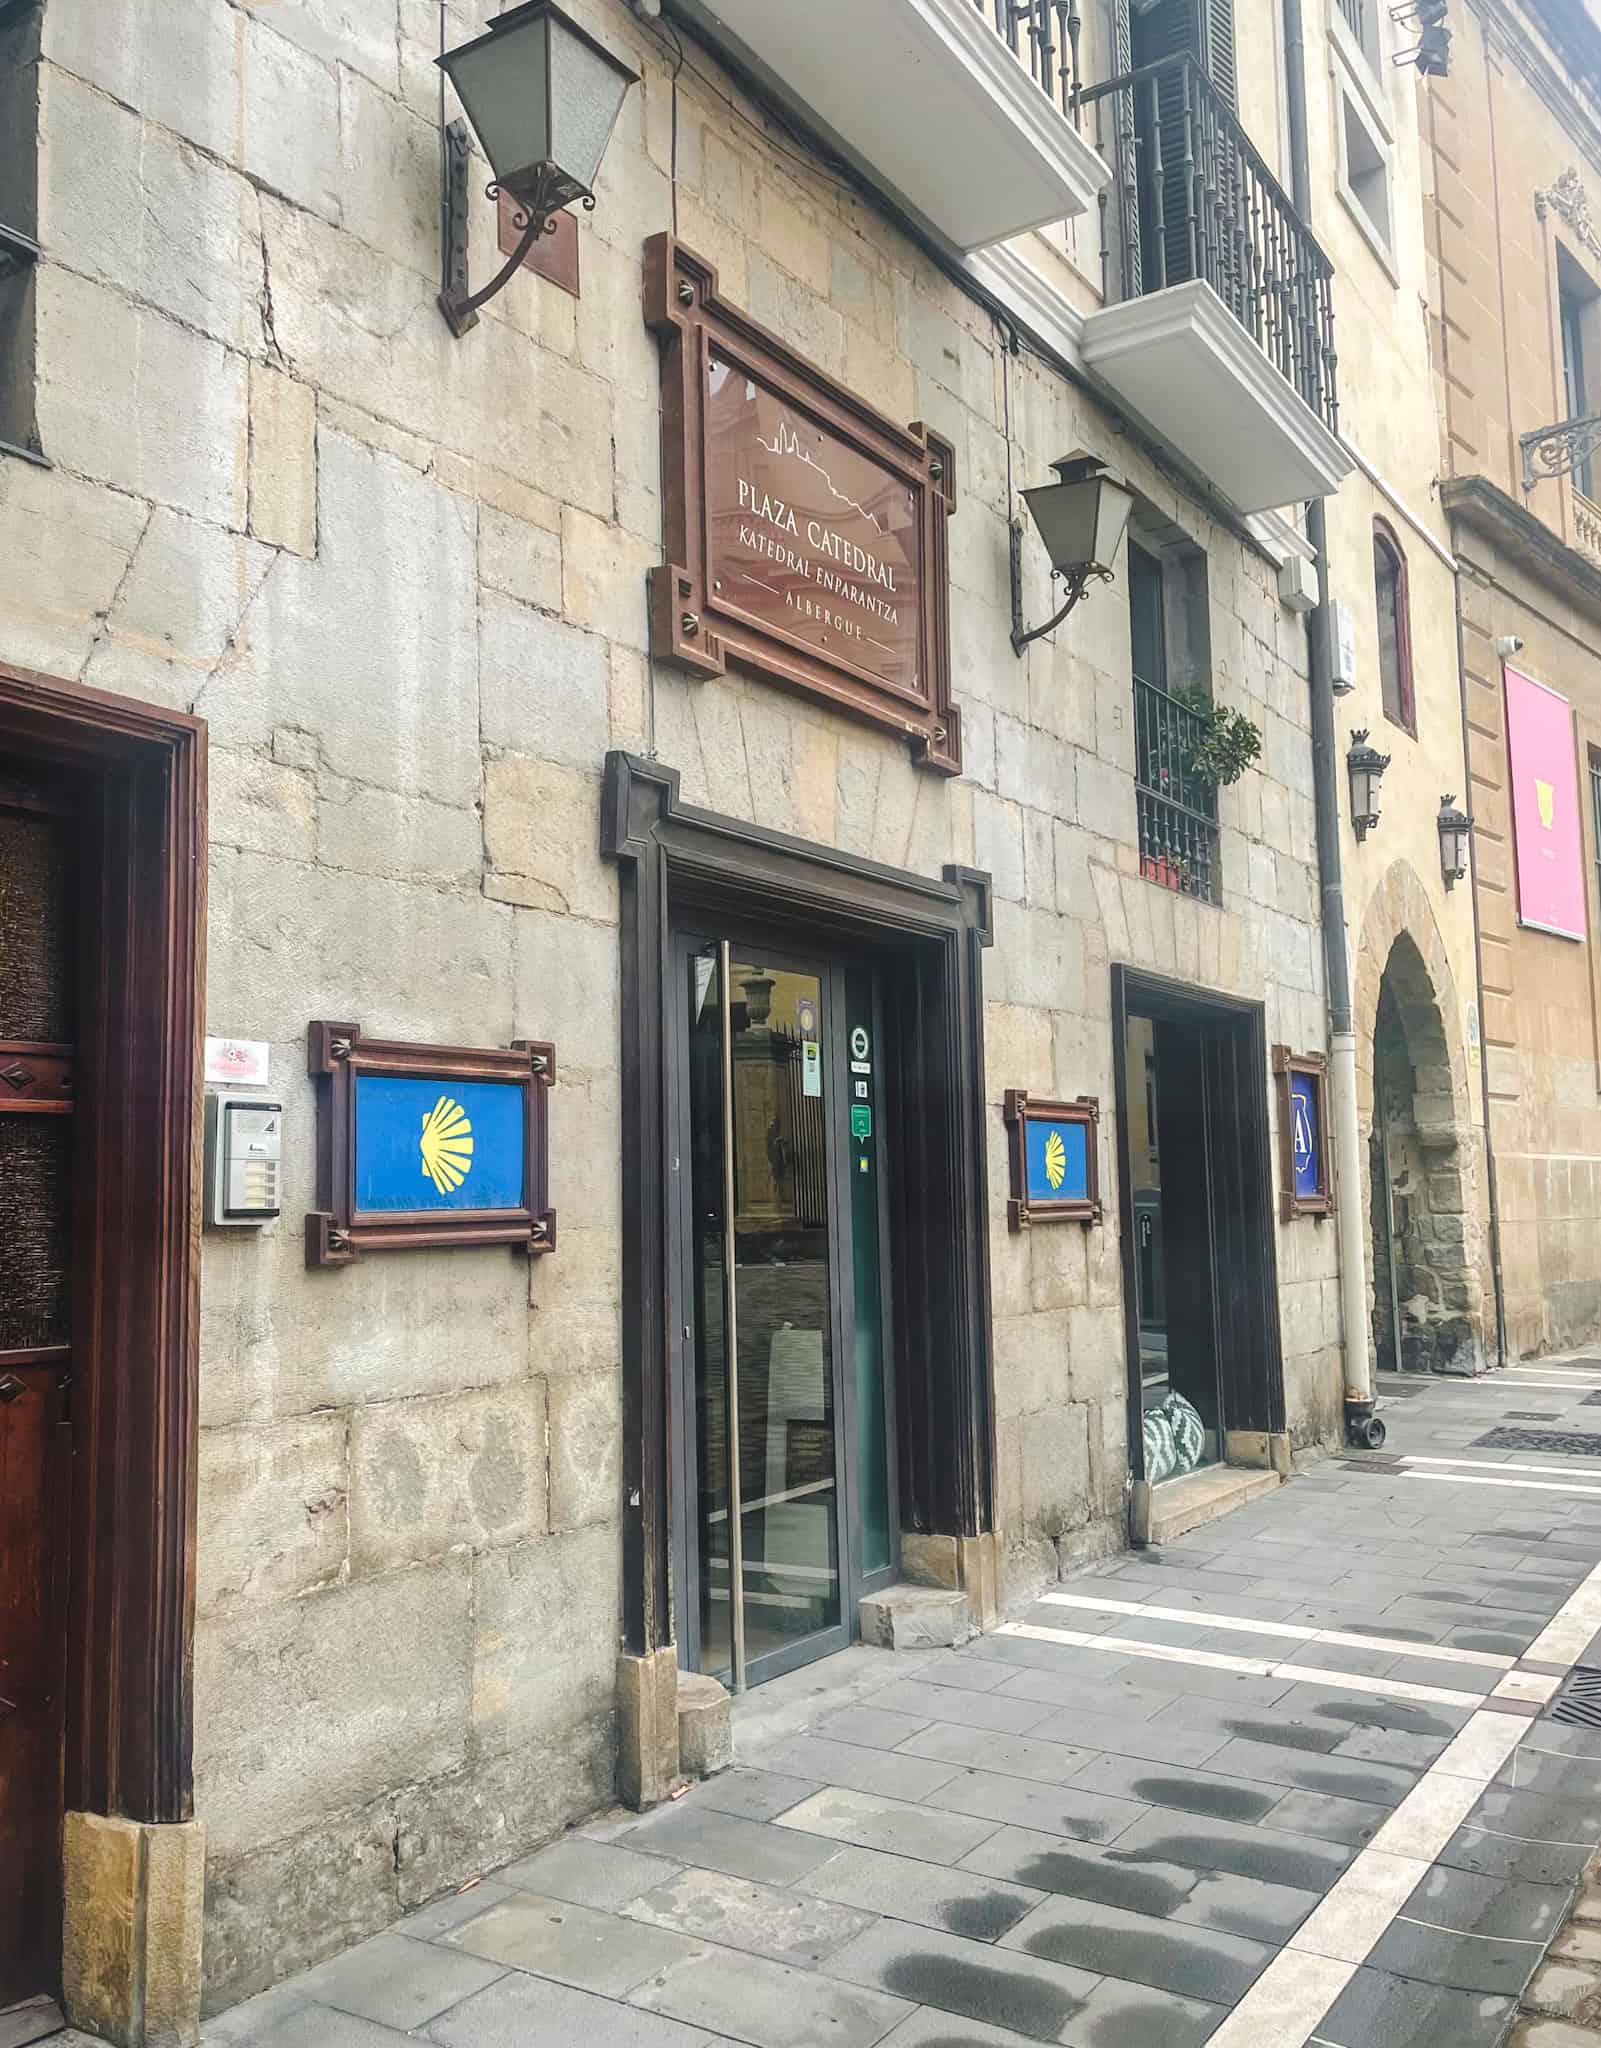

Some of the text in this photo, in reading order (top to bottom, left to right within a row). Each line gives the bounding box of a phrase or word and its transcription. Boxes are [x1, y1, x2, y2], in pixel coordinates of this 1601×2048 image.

[738, 479, 897, 592] PLAZA CATEDRAL
[739, 524, 898, 624] KATEDRAL ENPARANTZA
[785, 591, 862, 640] ALBERGUE
[1295, 1109, 1307, 1153] A
